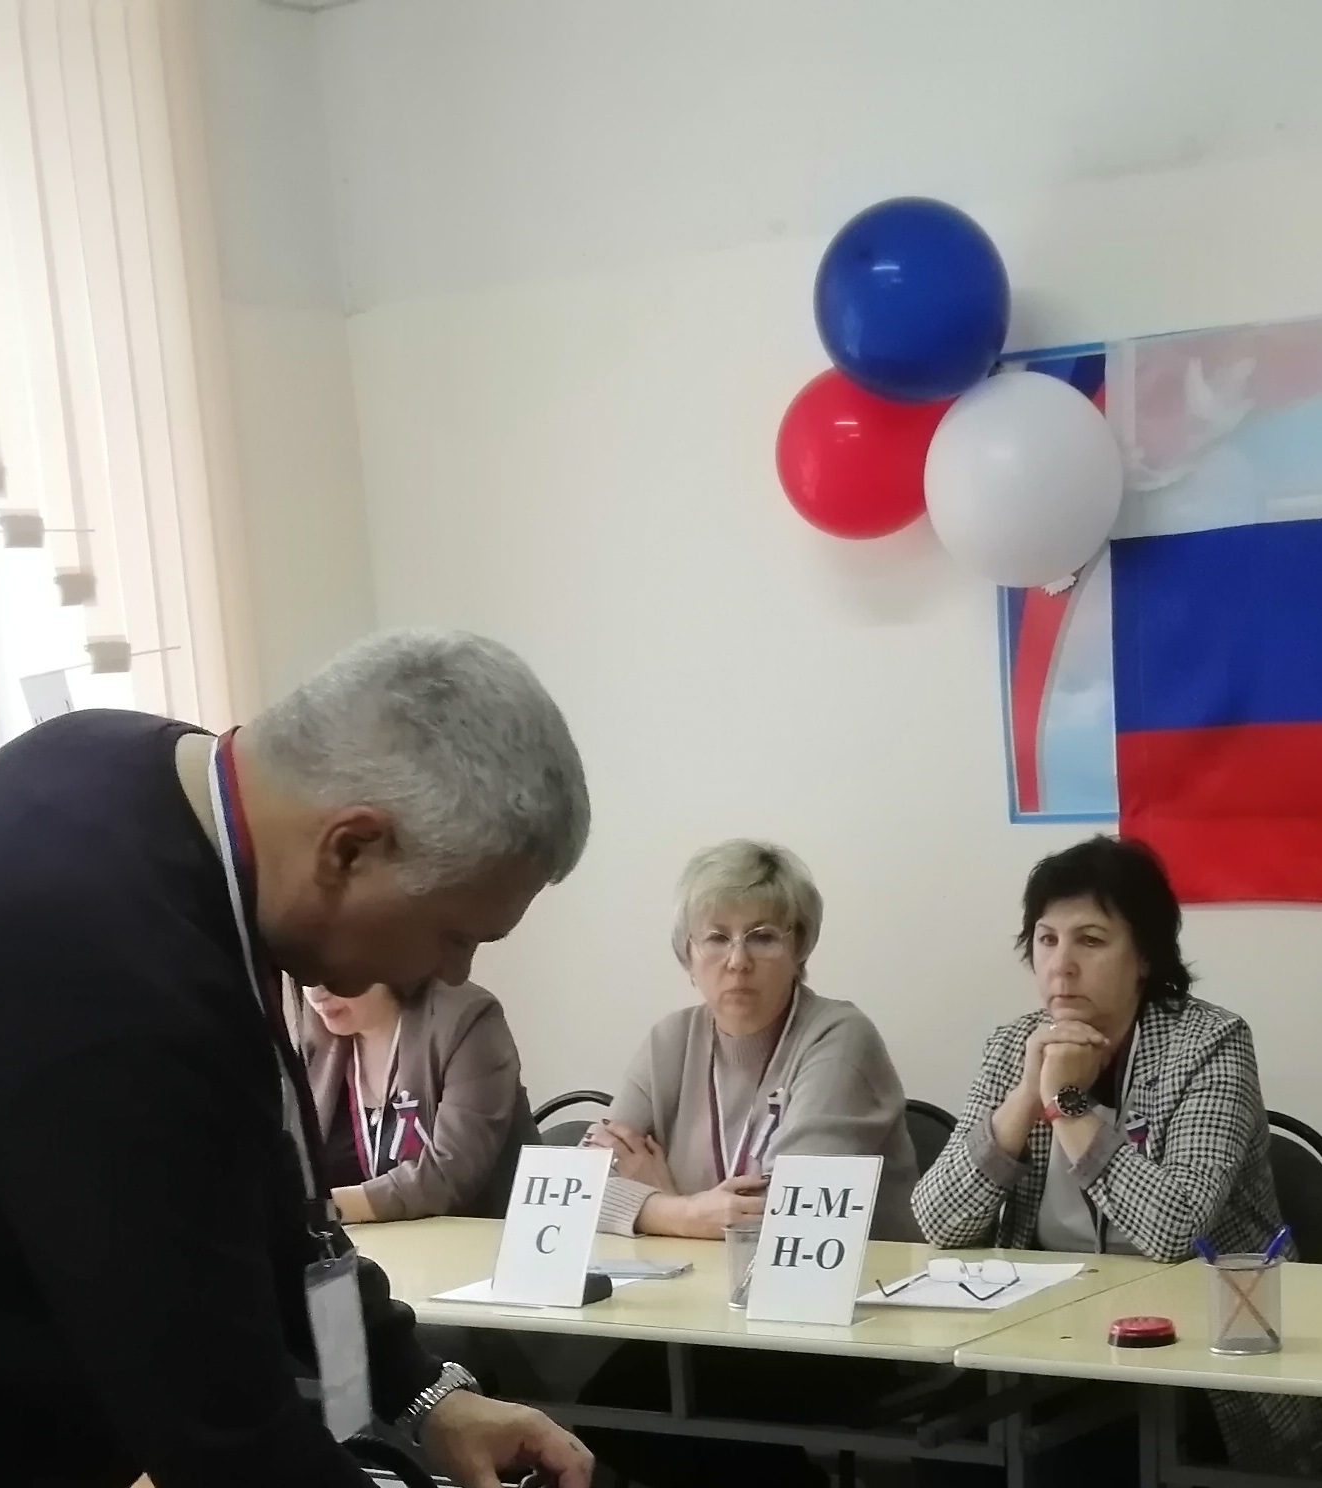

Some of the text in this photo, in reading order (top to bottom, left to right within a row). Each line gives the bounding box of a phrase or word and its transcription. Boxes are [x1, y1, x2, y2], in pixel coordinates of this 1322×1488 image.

[522, 1176, 592, 1207] П-Р-
[771, 1185, 864, 1219] Л-М-
[535, 1224, 562, 1255] С
[771, 1236, 846, 1270] Н-О
